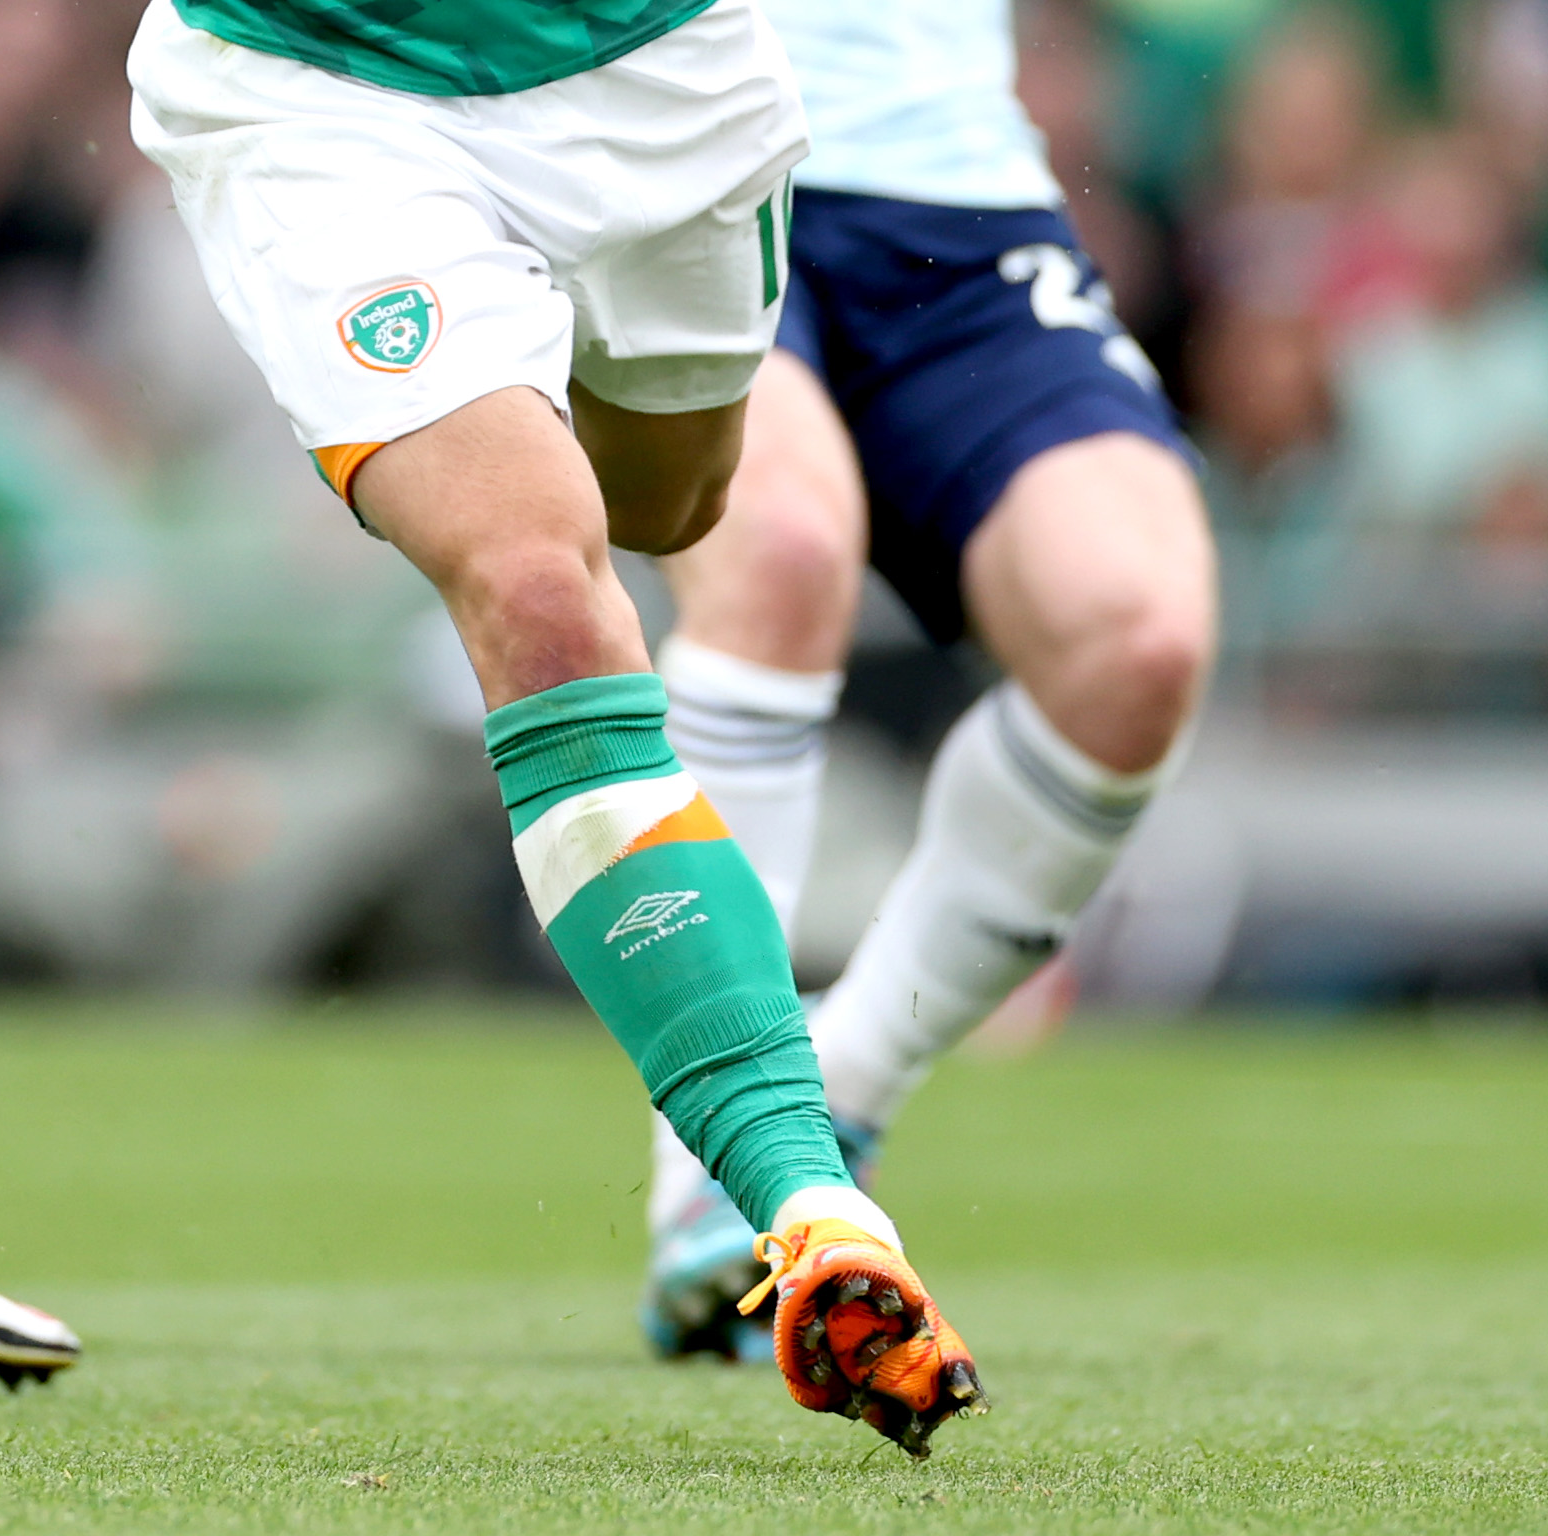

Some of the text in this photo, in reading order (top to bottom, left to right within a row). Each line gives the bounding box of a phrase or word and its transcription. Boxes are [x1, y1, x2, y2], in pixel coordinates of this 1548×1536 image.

[756, 170, 793, 310] 1
[353, 293, 417, 330] Ireland
[620, 913, 710, 961] umbro
